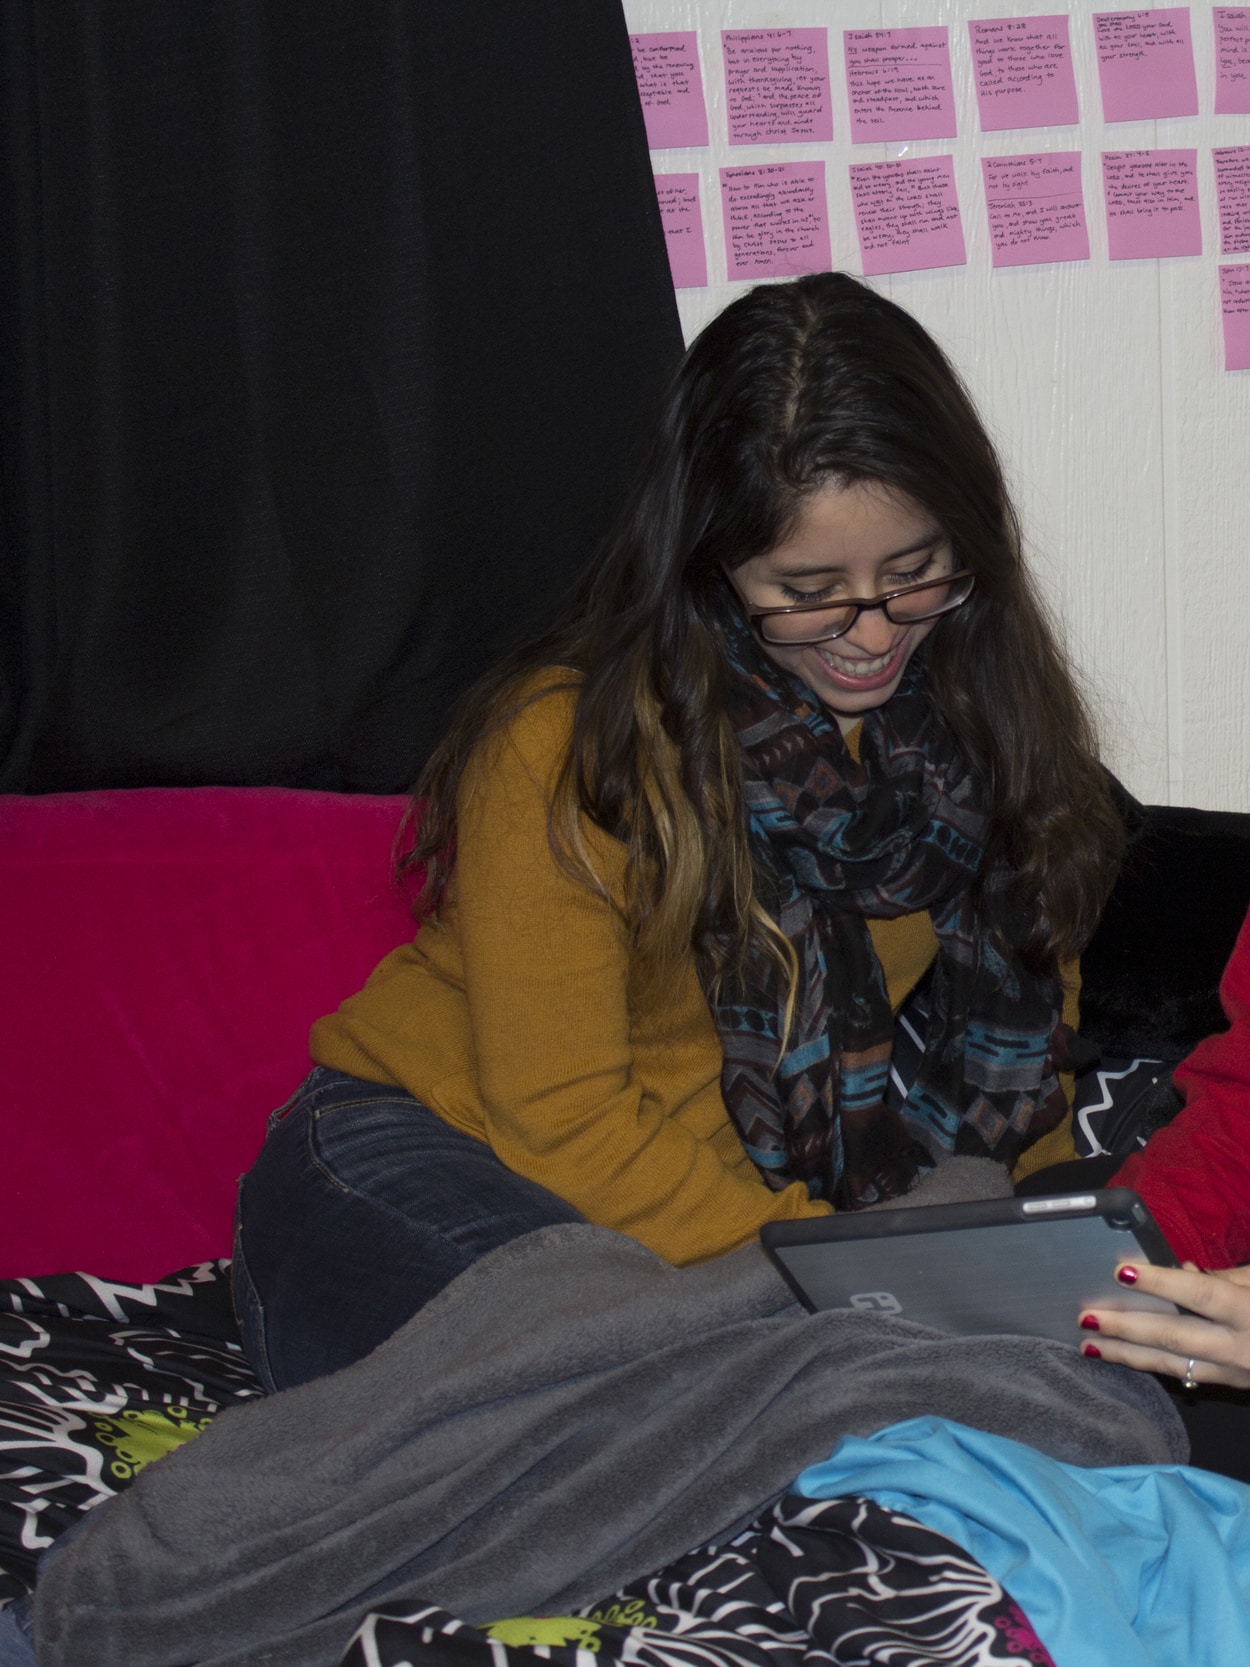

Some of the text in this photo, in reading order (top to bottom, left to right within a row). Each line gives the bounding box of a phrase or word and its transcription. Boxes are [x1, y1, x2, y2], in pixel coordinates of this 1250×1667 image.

[1217, 10, 1247, 19] Isaiah
[974, 24, 1003, 34] Romans
[726, 34, 764, 43] Philippians
[1219, 36, 1243, 45] perfect
[785, 44, 816, 54] nothing,
[920, 41, 947, 50] against
[976, 47, 995, 58] things
[1019, 44, 1050, 55] together
[752, 56, 789, 66] everything
[977, 57, 993, 68] good
[728, 69, 750, 77] prayer
[749, 77, 795, 86] thanksgiving,
[867, 79, 881, 88] hope
[979, 76, 1003, 87] called
[1007, 74, 1042, 86] according
[798, 105, 822, 118] guard
[732, 123, 746, 131] your
[733, 130, 762, 140] through
[1030, 170, 1041, 179] by
[1002, 181, 1011, 192] by
[993, 231, 1006, 239] and
